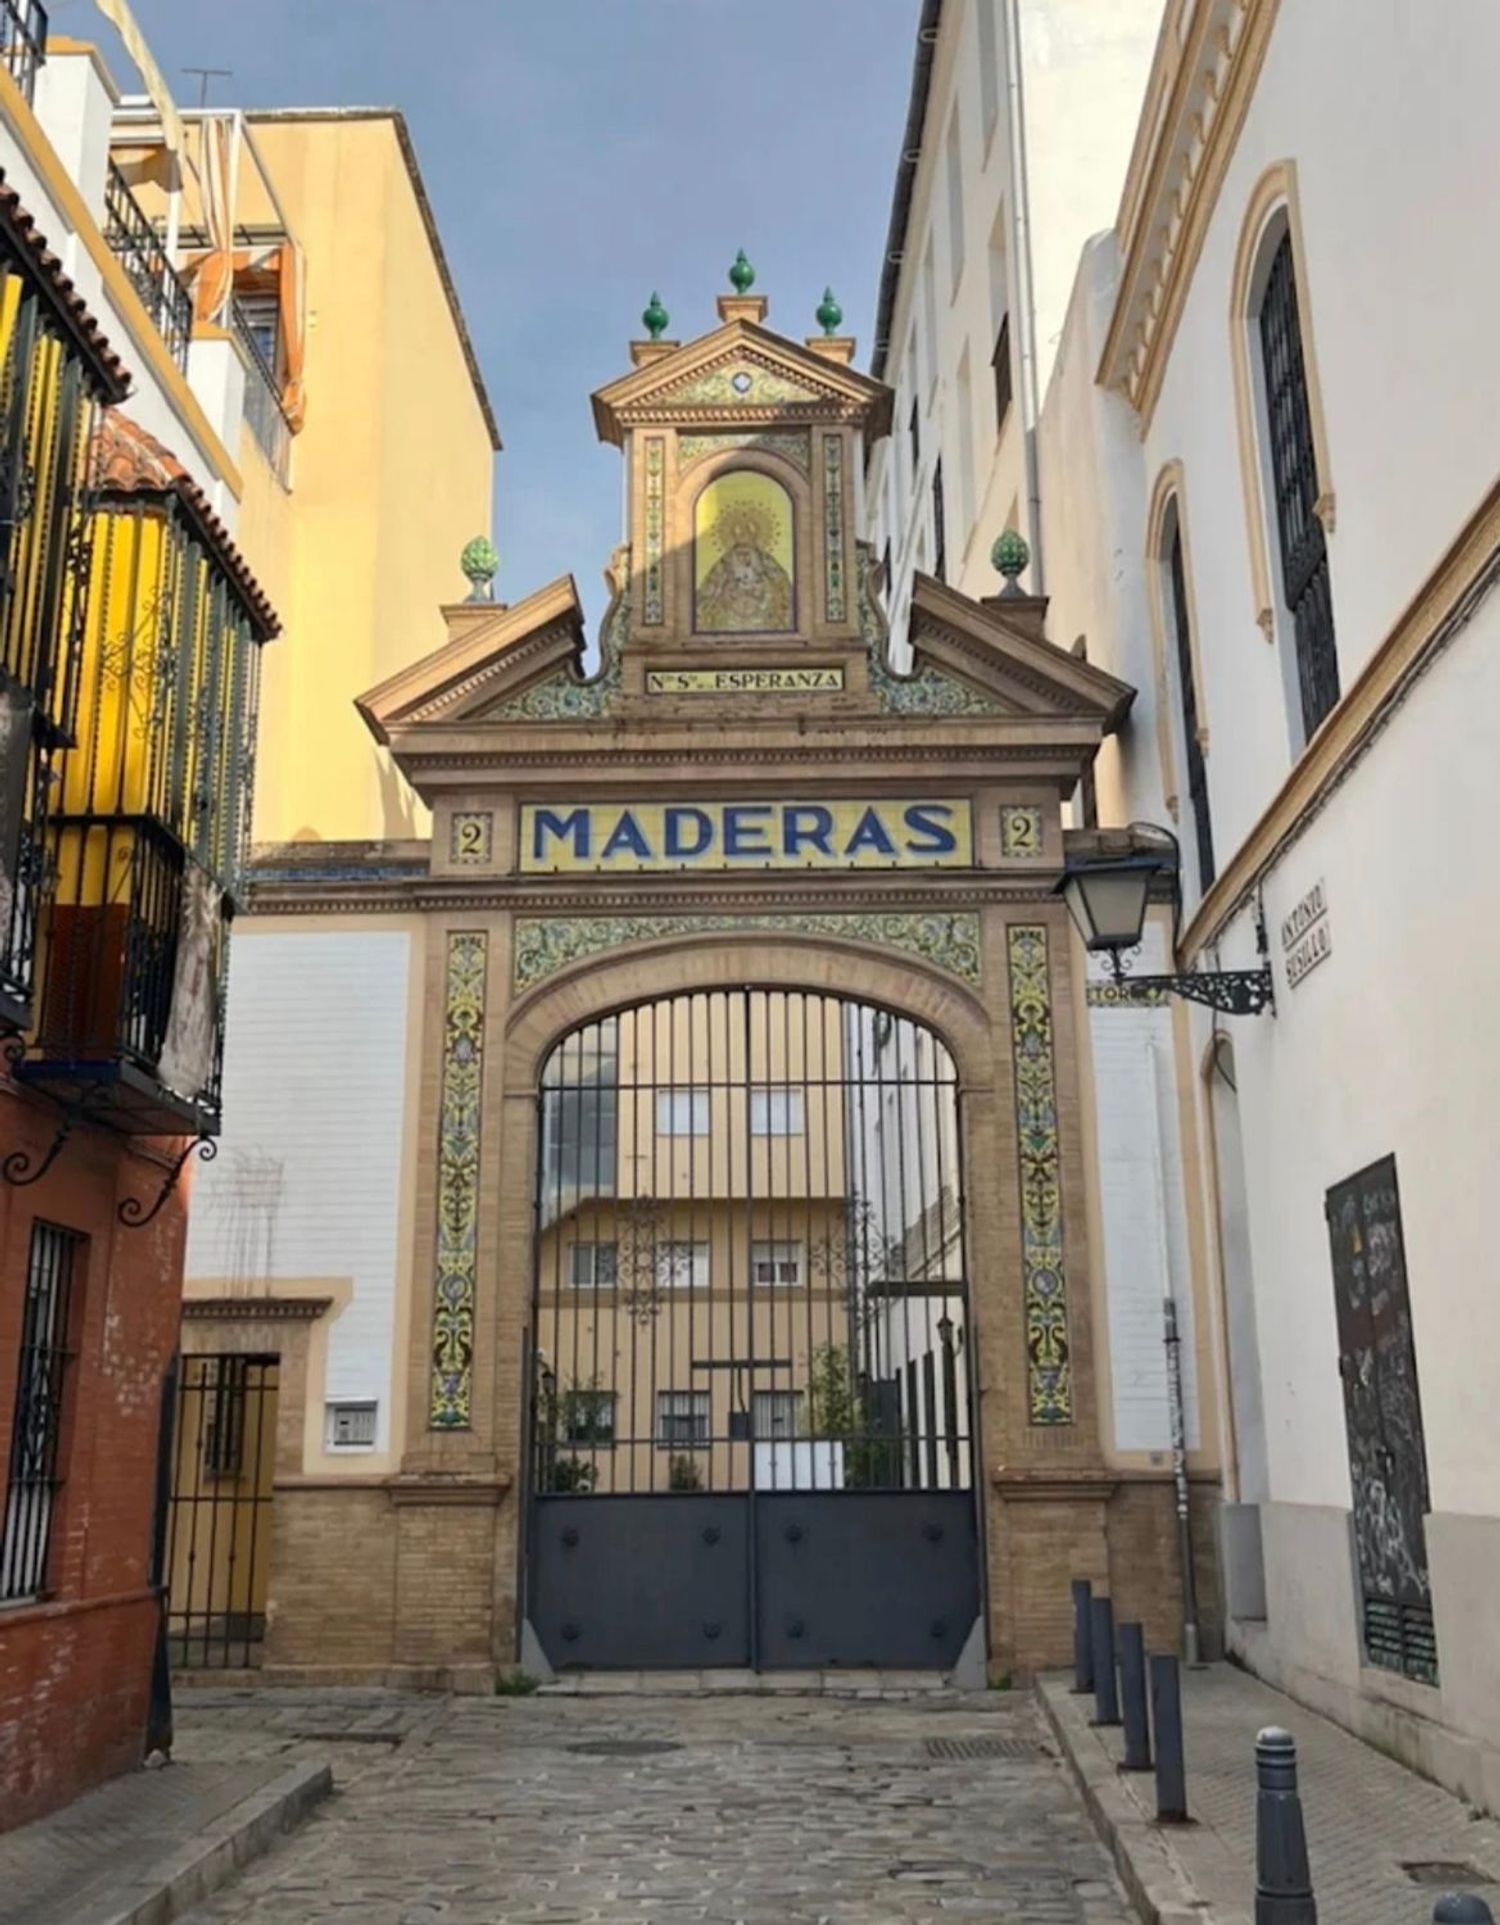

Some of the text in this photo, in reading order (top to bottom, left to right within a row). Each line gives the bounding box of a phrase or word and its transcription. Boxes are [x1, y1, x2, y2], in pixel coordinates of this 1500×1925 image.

[715, 672, 840, 689] ESPERANZA
[462, 822, 481, 854] 2
[533, 804, 957, 859] MADERAS
[1012, 816, 1032, 847] 2
